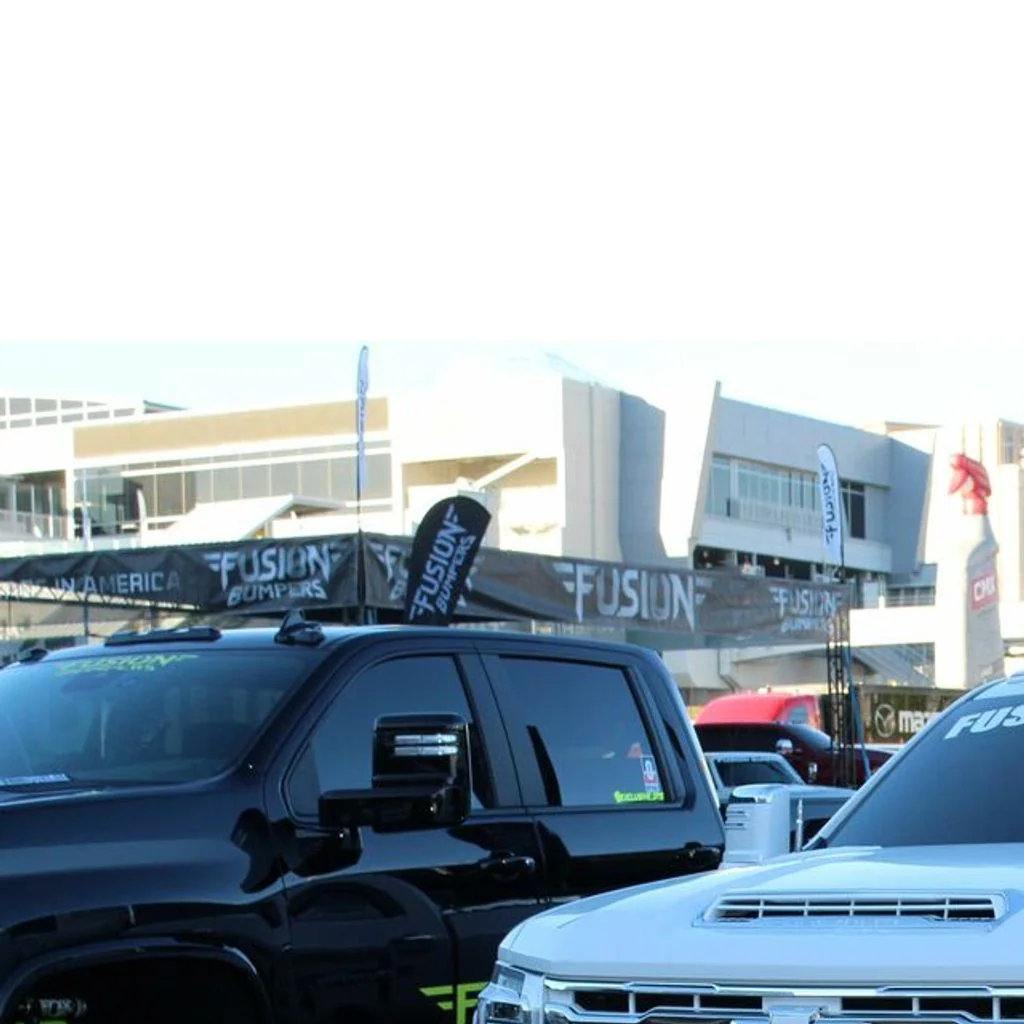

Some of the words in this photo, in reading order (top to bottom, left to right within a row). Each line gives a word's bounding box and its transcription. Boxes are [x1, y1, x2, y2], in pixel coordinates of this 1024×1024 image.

[83, 571, 181, 594] AMERICA
[204, 542, 346, 592] FUSION
[408, 503, 468, 621] FUSION
[227, 578, 328, 607] BUMPERS
[552, 562, 713, 633] FUSION
[768, 585, 846, 619] FUSION
